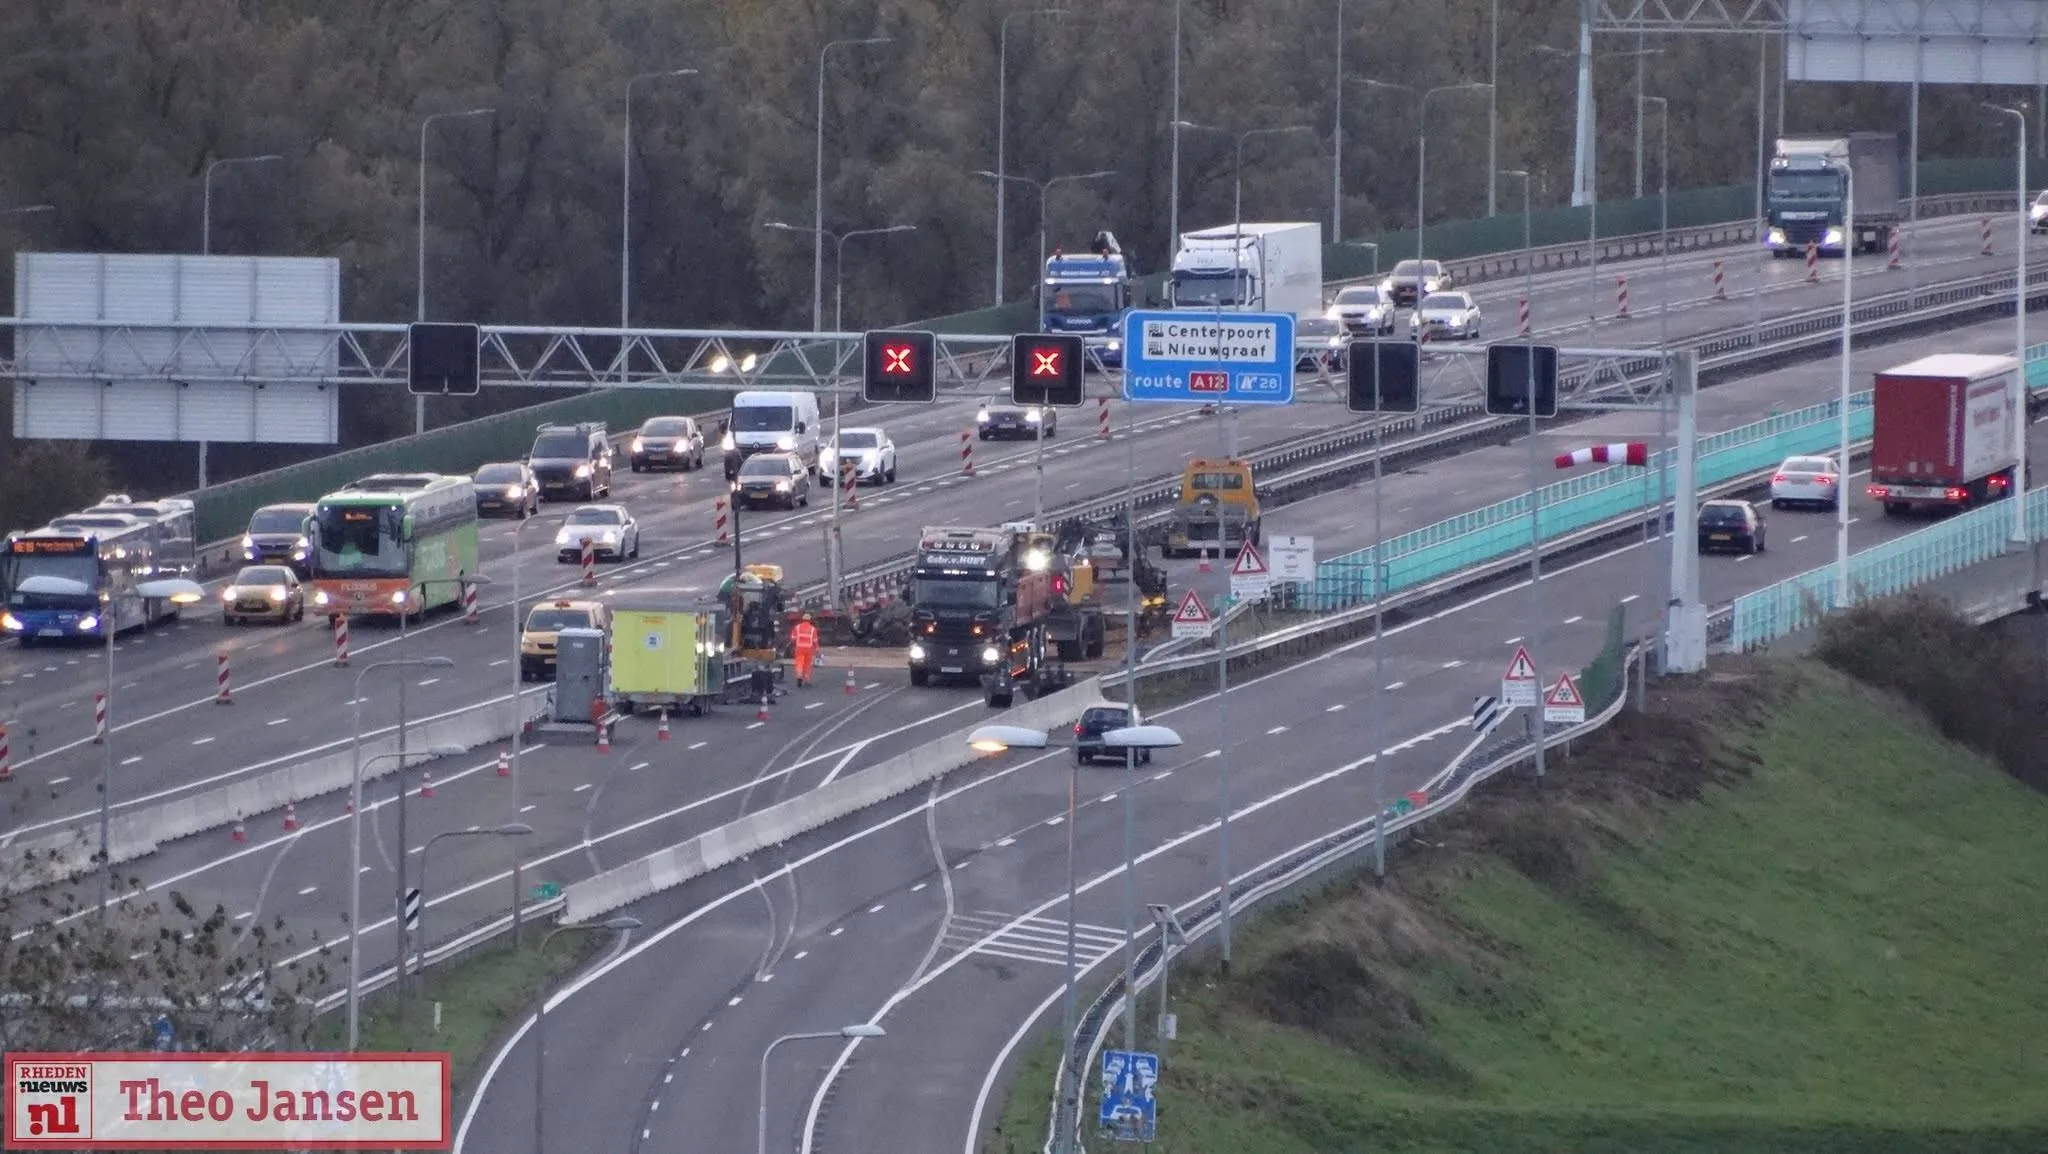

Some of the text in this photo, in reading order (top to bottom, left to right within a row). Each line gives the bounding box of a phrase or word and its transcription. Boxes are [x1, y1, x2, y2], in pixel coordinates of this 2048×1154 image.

[1168, 324, 1271, 340] Centerpoort
[1168, 343, 1267, 358] Nieuwgraaf
[1135, 373, 1278, 389] route A12 28
